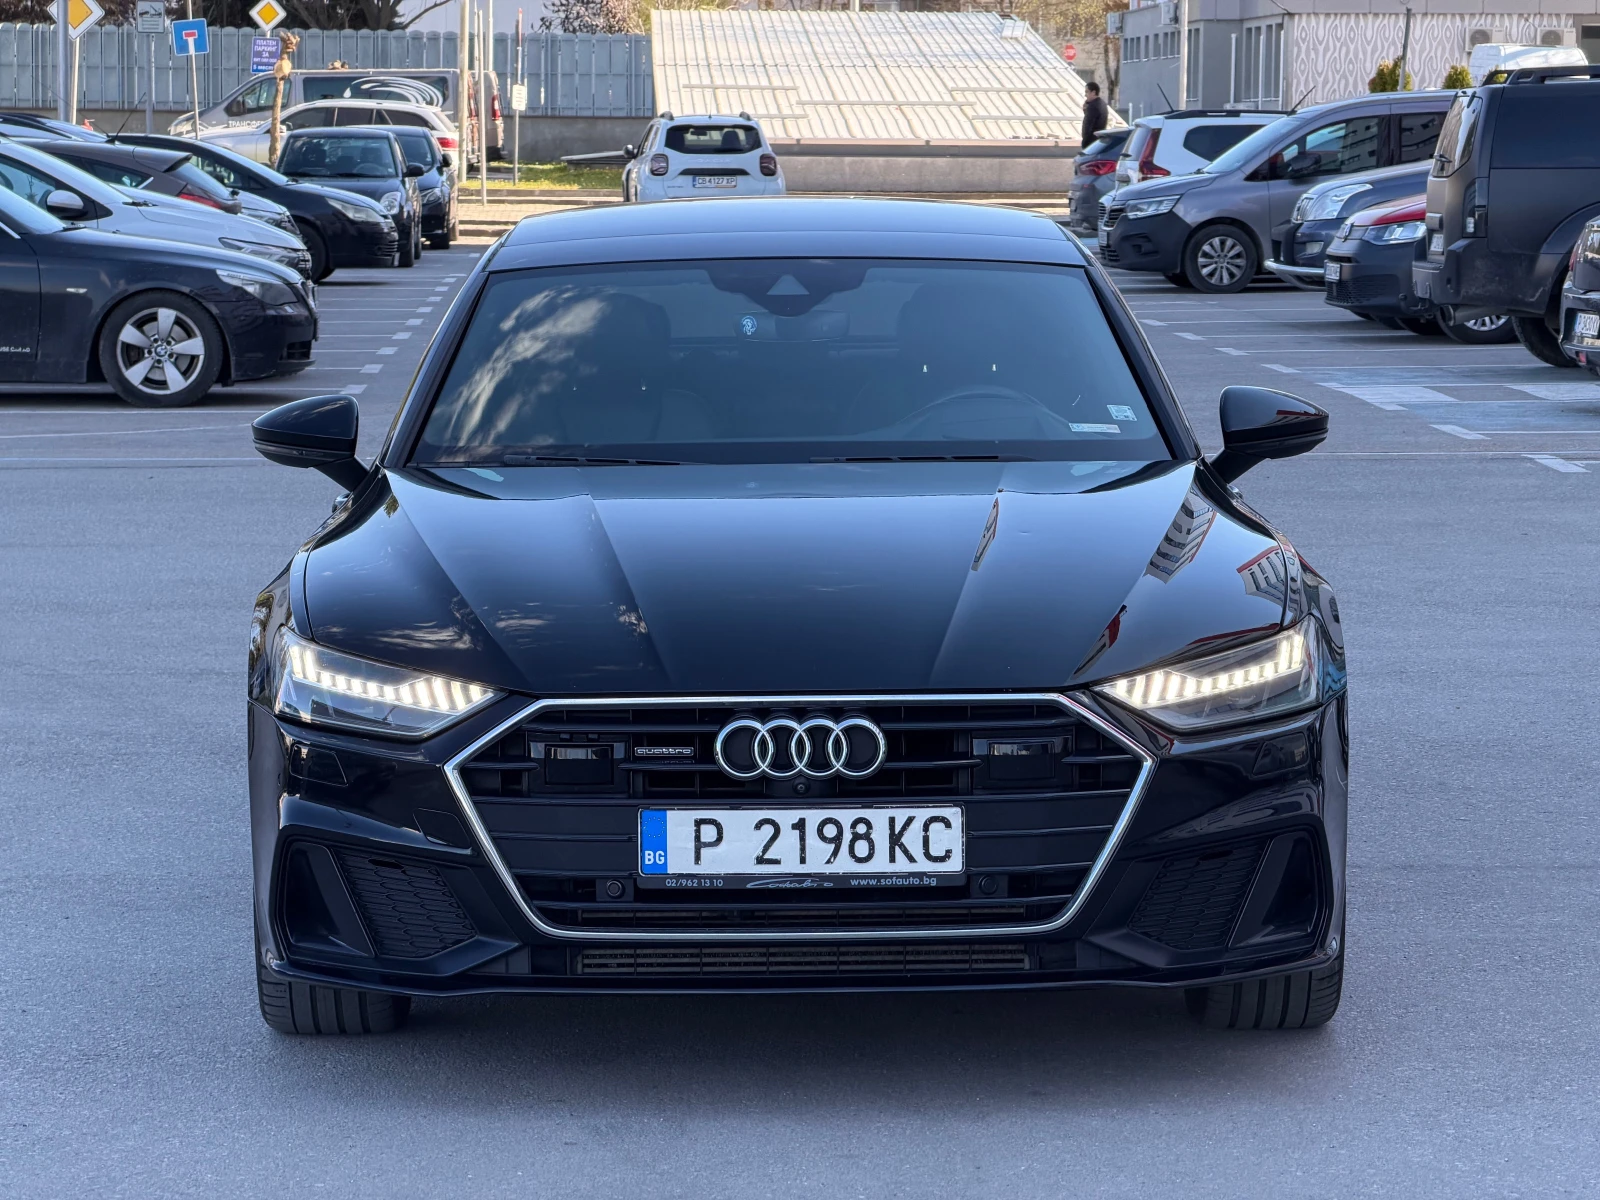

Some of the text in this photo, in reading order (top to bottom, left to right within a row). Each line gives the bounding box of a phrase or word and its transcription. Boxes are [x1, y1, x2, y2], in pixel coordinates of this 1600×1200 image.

[707, 177, 724, 185] 4127
[693, 817, 724, 866] P
[644, 851, 665, 865] BG
[665, 878, 724, 887] 02/962 13 10
[850, 875, 937, 887] www.sofauto.bg
